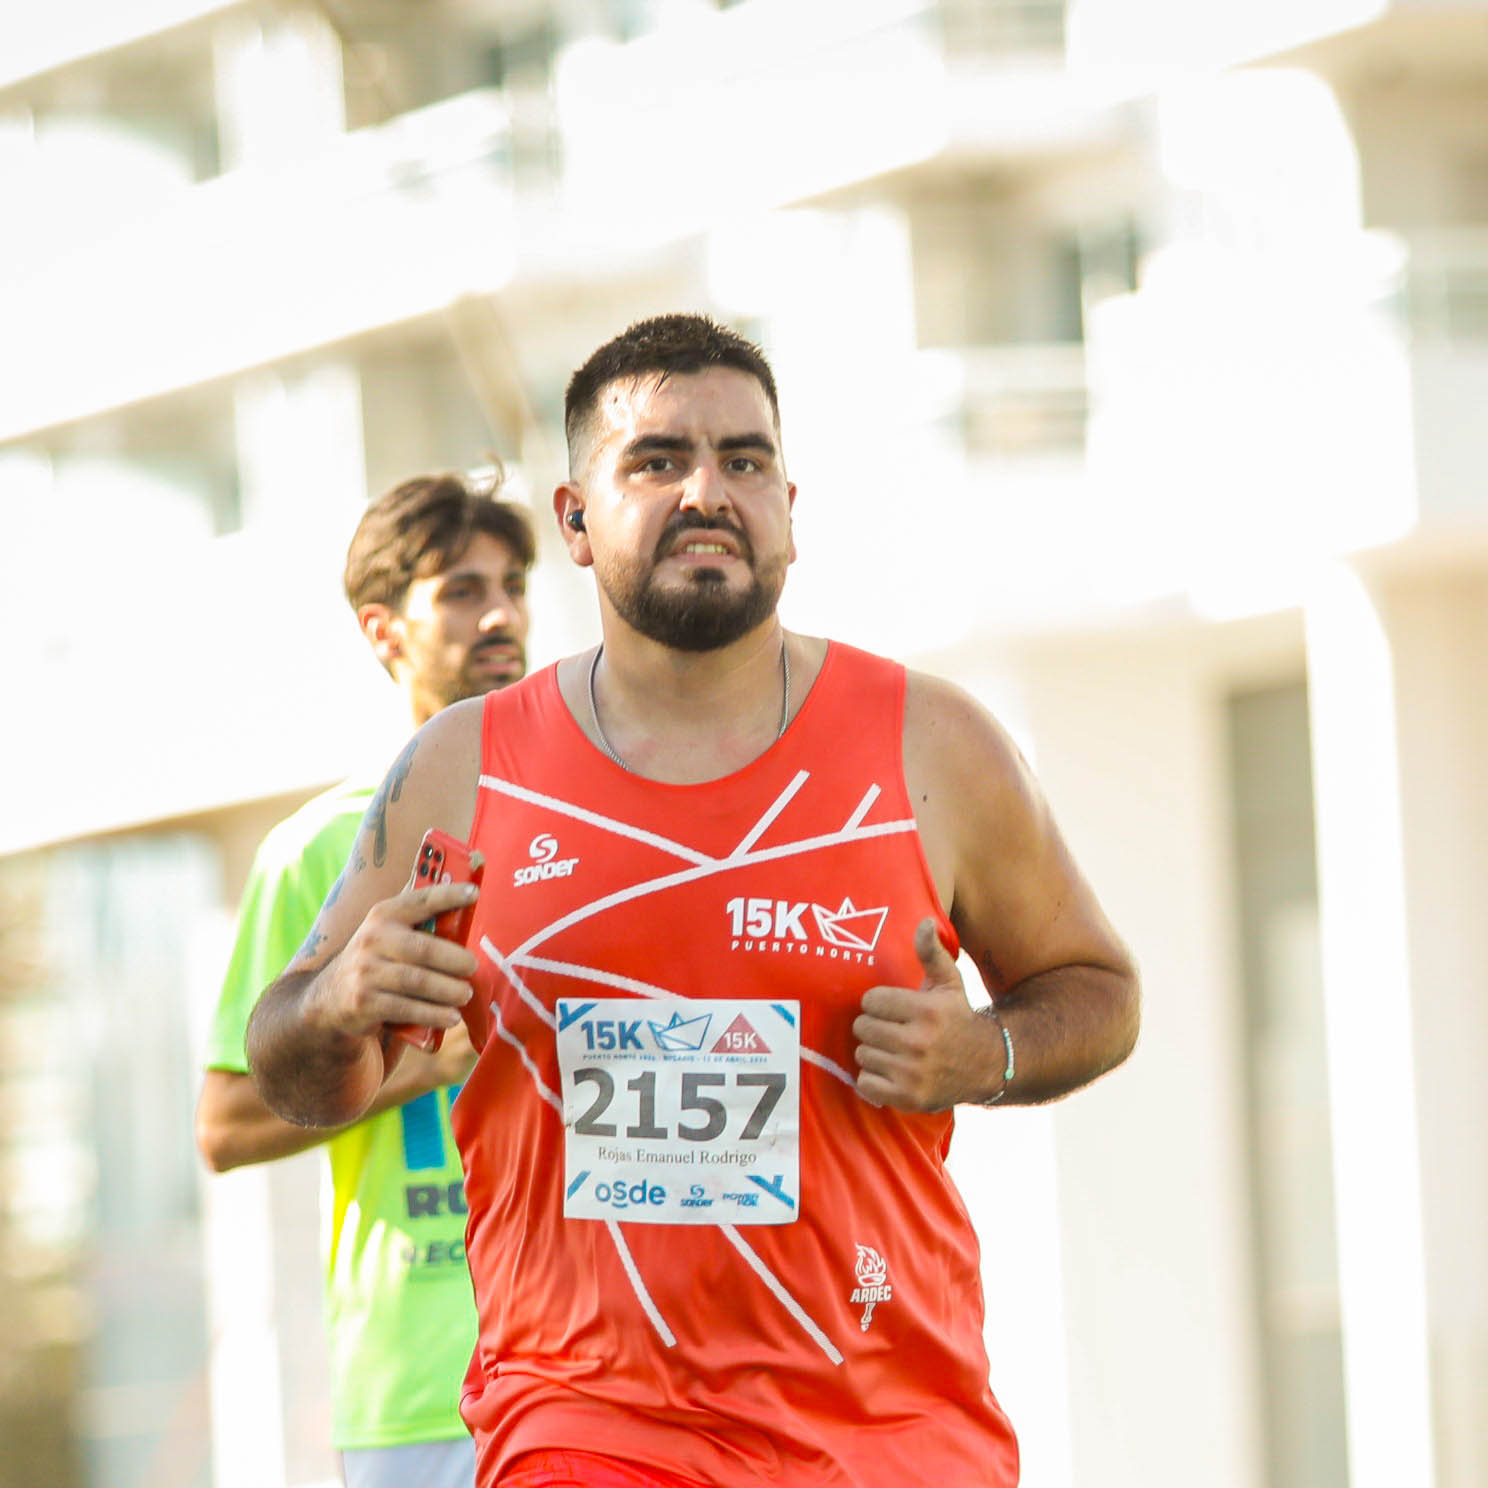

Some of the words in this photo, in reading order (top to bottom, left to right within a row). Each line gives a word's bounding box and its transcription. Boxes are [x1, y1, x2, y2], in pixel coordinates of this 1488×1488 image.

[726, 897, 809, 940] 15K
[731, 940, 808, 954] PUERTO
[815, 946, 874, 966] NORTE
[580, 1020, 645, 1050] 15K
[723, 1031, 758, 1049] 15K
[573, 1067, 787, 1142] 2157
[598, 1147, 632, 1163] Rojas
[636, 1149, 695, 1164] Emanuel
[699, 1150, 757, 1167] Rodrigo
[849, 1285, 892, 1303] ARDEC
